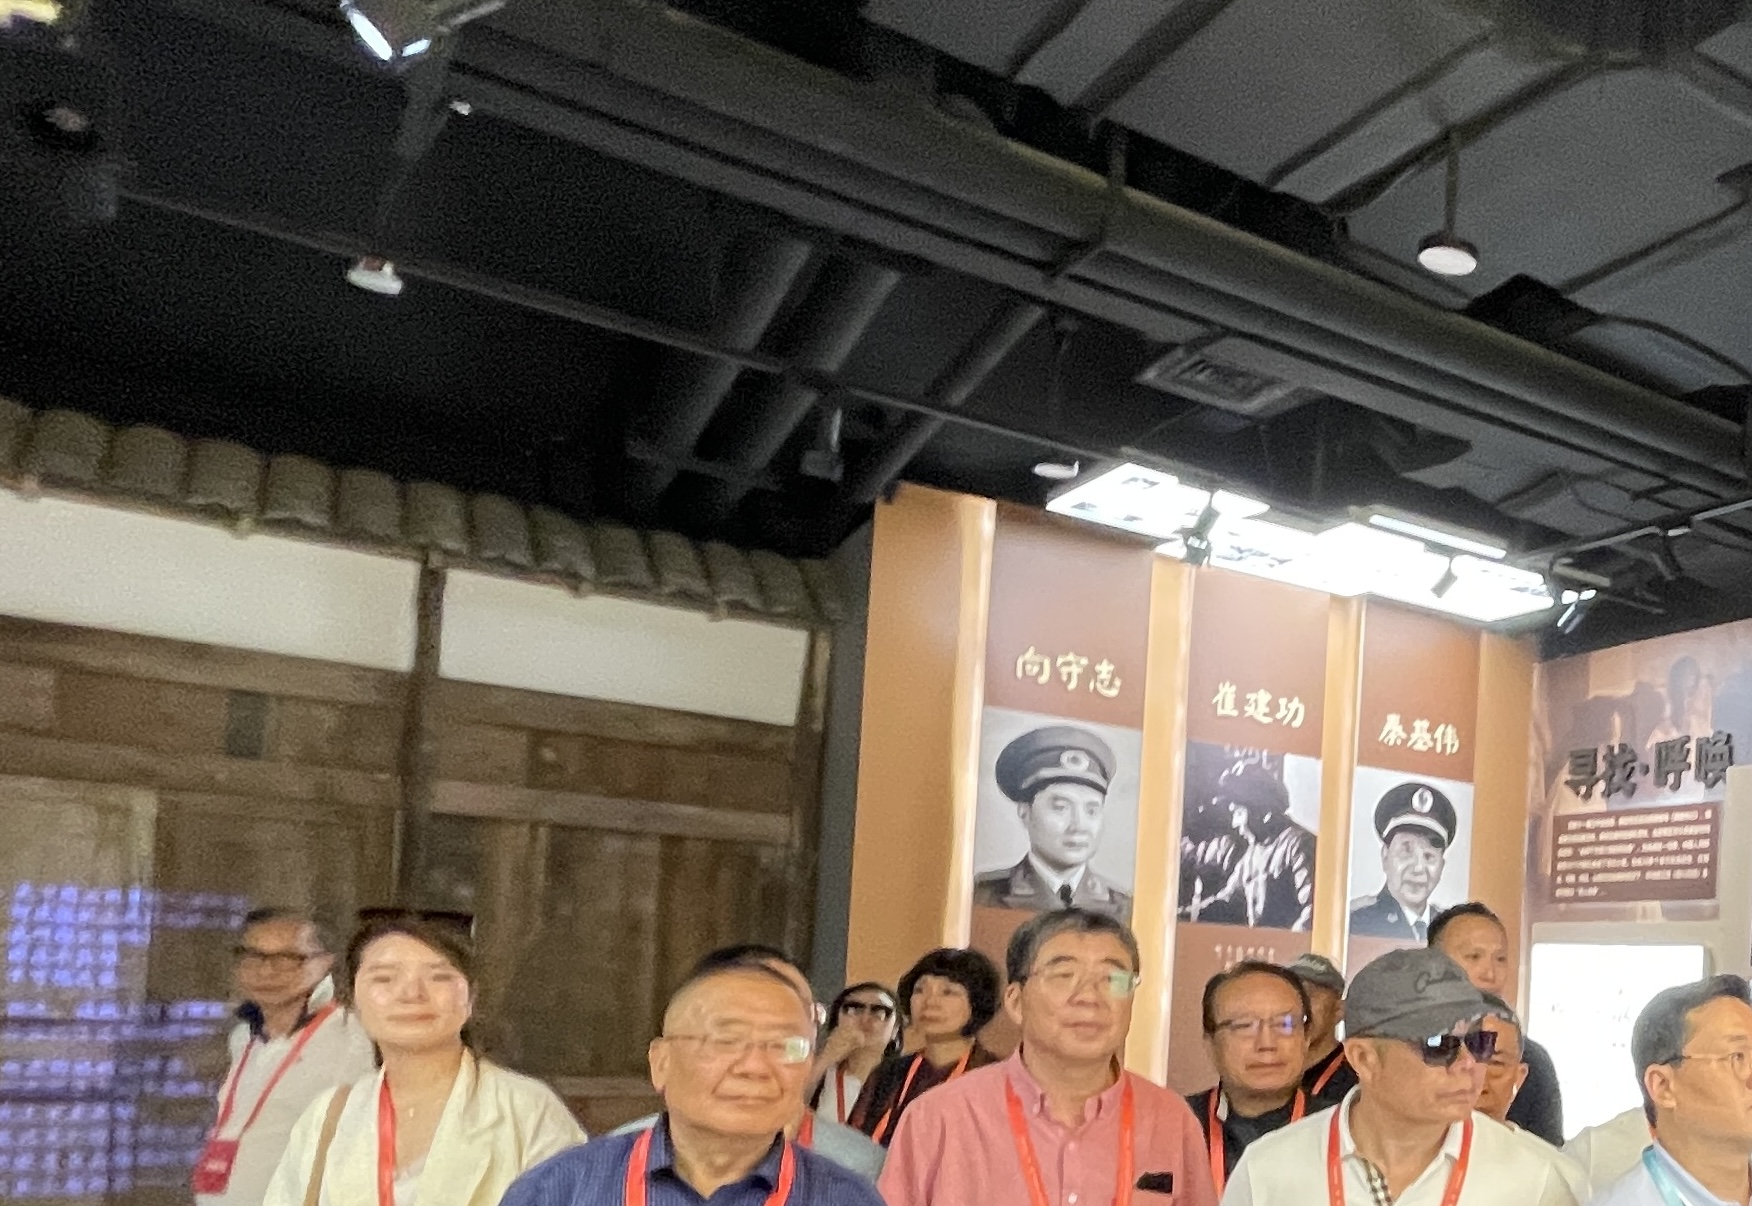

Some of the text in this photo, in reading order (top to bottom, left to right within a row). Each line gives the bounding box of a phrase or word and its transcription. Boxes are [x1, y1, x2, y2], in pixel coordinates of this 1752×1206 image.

[1015, 645, 1122, 699] 向守志
[1211, 681, 1306, 728] 崔建功
[1377, 712, 1460, 756] 秦基伟
